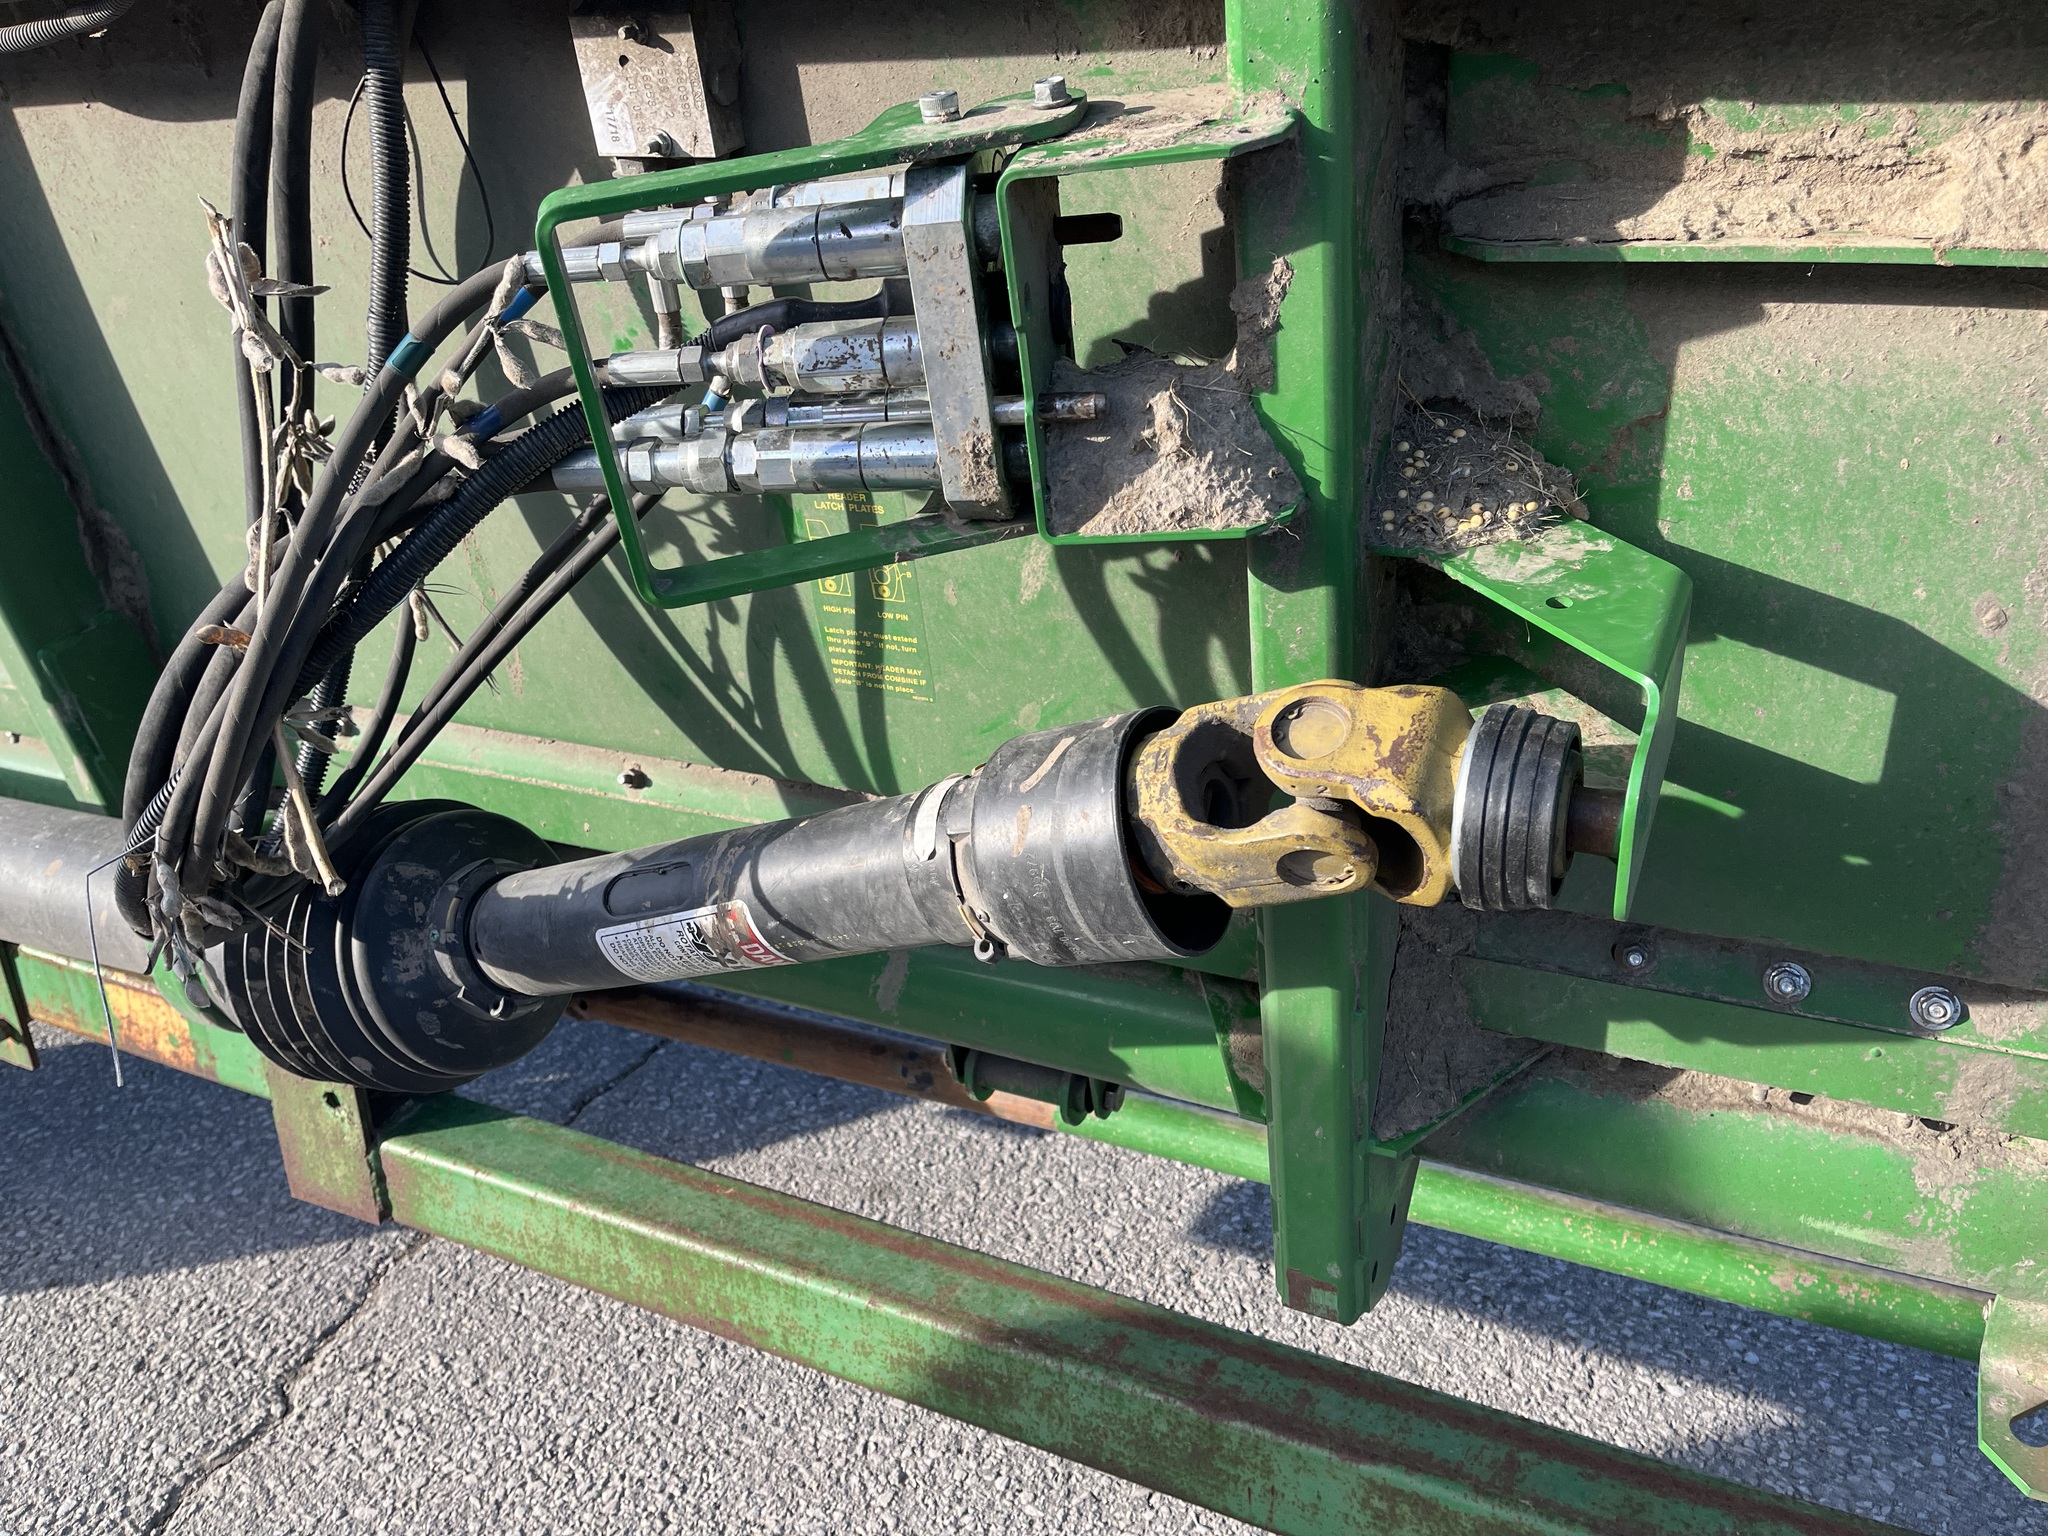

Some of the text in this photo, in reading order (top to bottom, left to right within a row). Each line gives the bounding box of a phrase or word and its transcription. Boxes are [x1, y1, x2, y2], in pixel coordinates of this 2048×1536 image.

[828, 493, 866, 502] HEADER
[814, 501, 884, 514] LATCH PLATES
[823, 605, 841, 613] HIGH
[824, 626, 844, 634] Latch
[893, 635, 917, 643] extend
[829, 646, 846, 654] plate
[902, 645, 917, 653] turn
[832, 667, 860, 677] DETACH
[863, 672, 883, 680] FROM
[885, 675, 918, 685] COMBINE
[907, 667, 922, 676] MAY
[835, 677, 851, 685] plate
[895, 685, 916, 694] place.
[656, 936, 666, 948] DO
[610, 942, 632, 968] DO NOT
